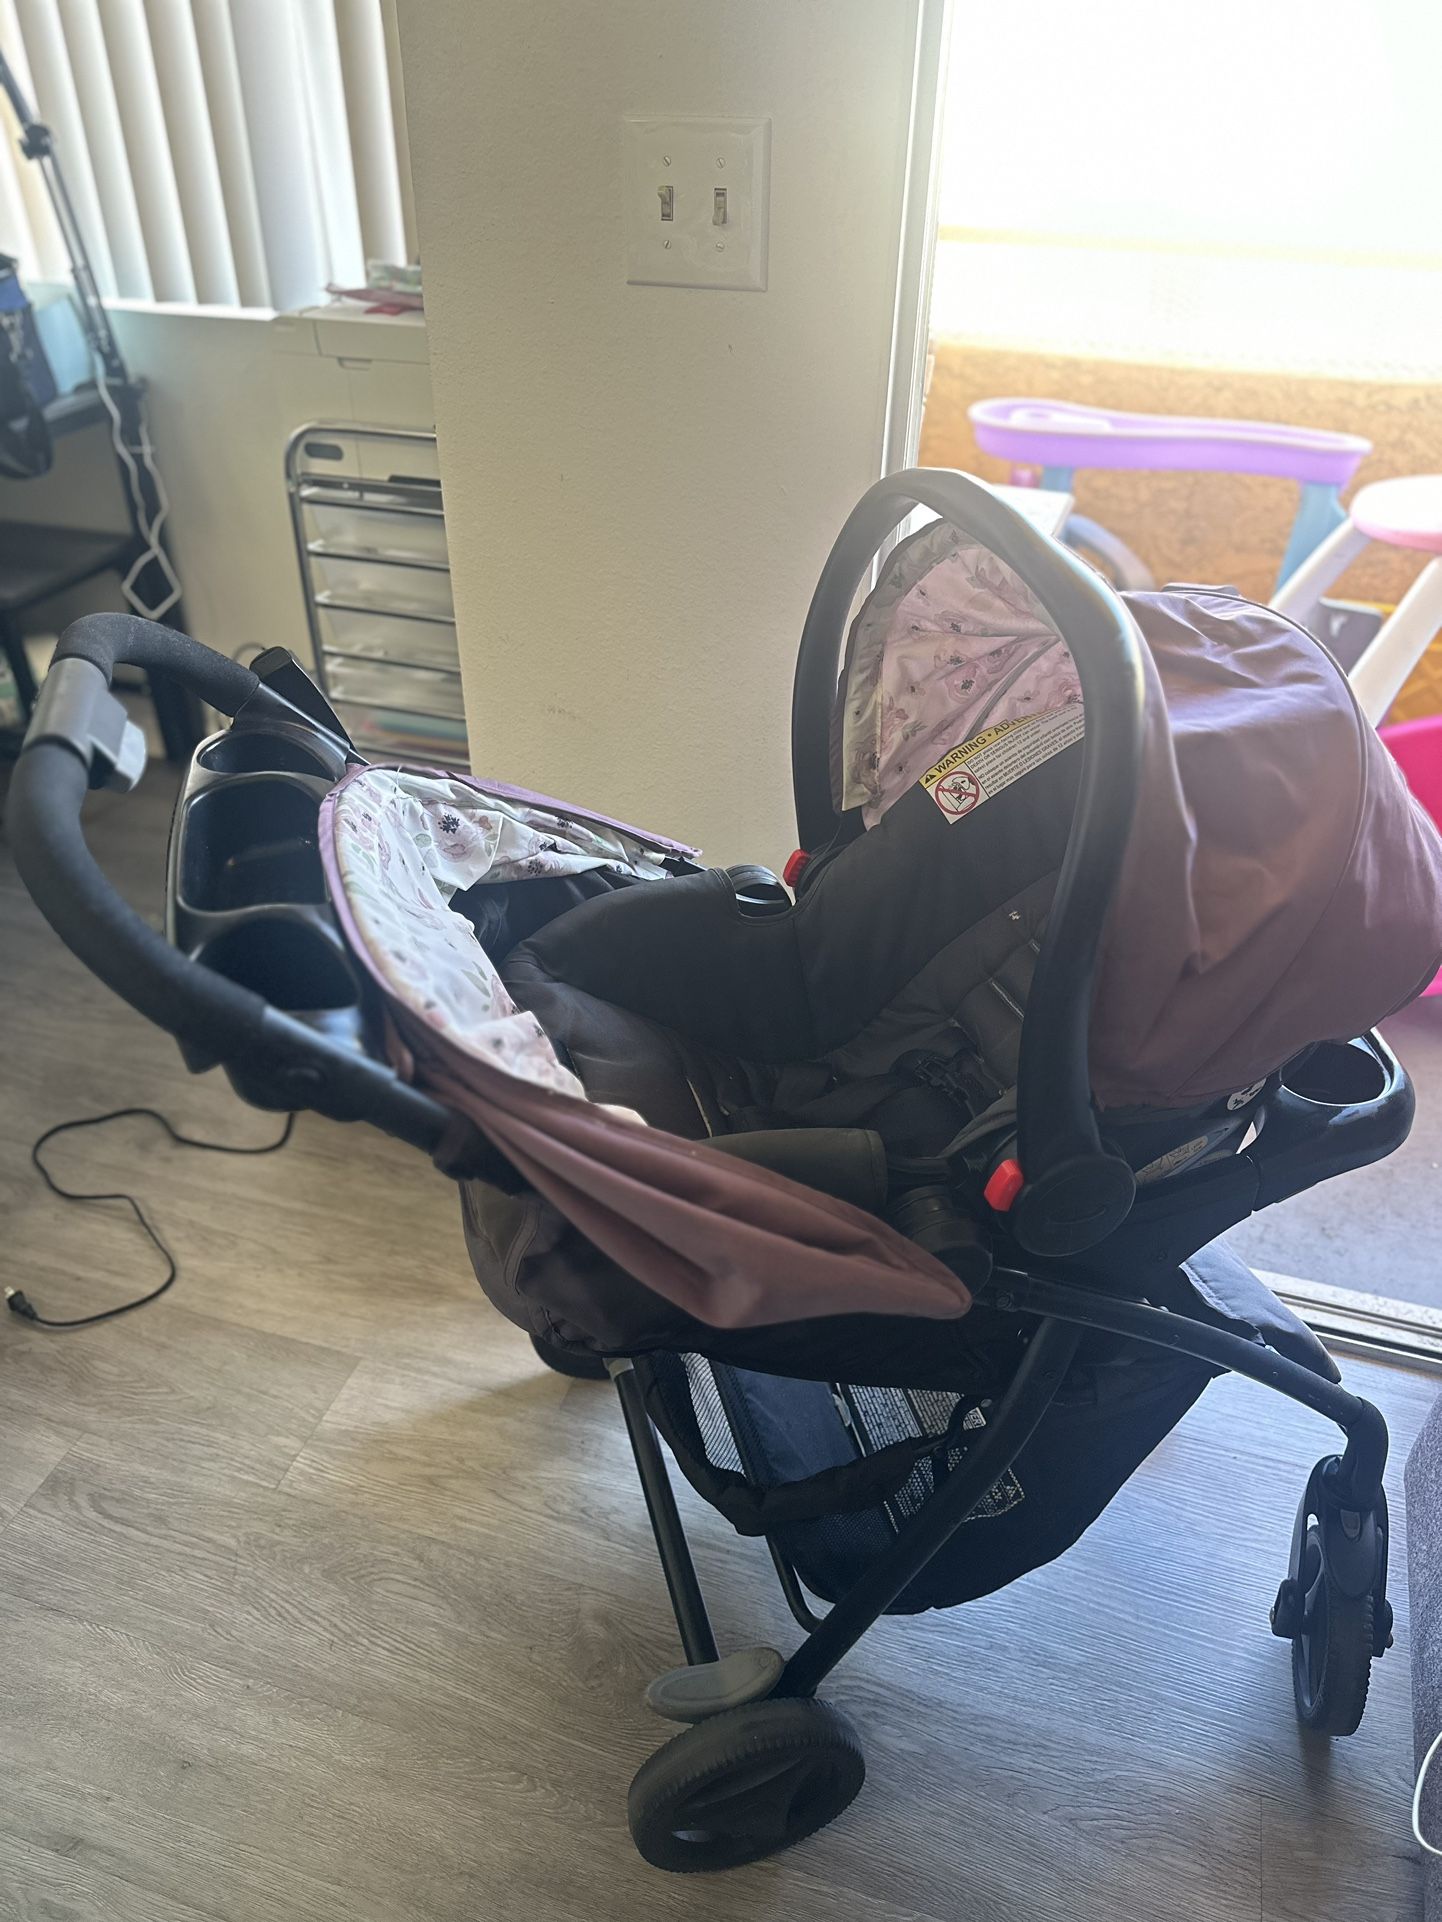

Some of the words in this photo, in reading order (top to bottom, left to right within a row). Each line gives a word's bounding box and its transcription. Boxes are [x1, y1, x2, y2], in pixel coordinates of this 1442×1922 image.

[935, 735, 986, 772] WARNING
[969, 758, 984, 769] DEATH
[990, 742, 1008, 755] SERIOUS
[1007, 733, 1022, 744] INJURY
[1002, 764, 1019, 776] MUERTE
[1021, 749, 1042, 764] LESIONES
